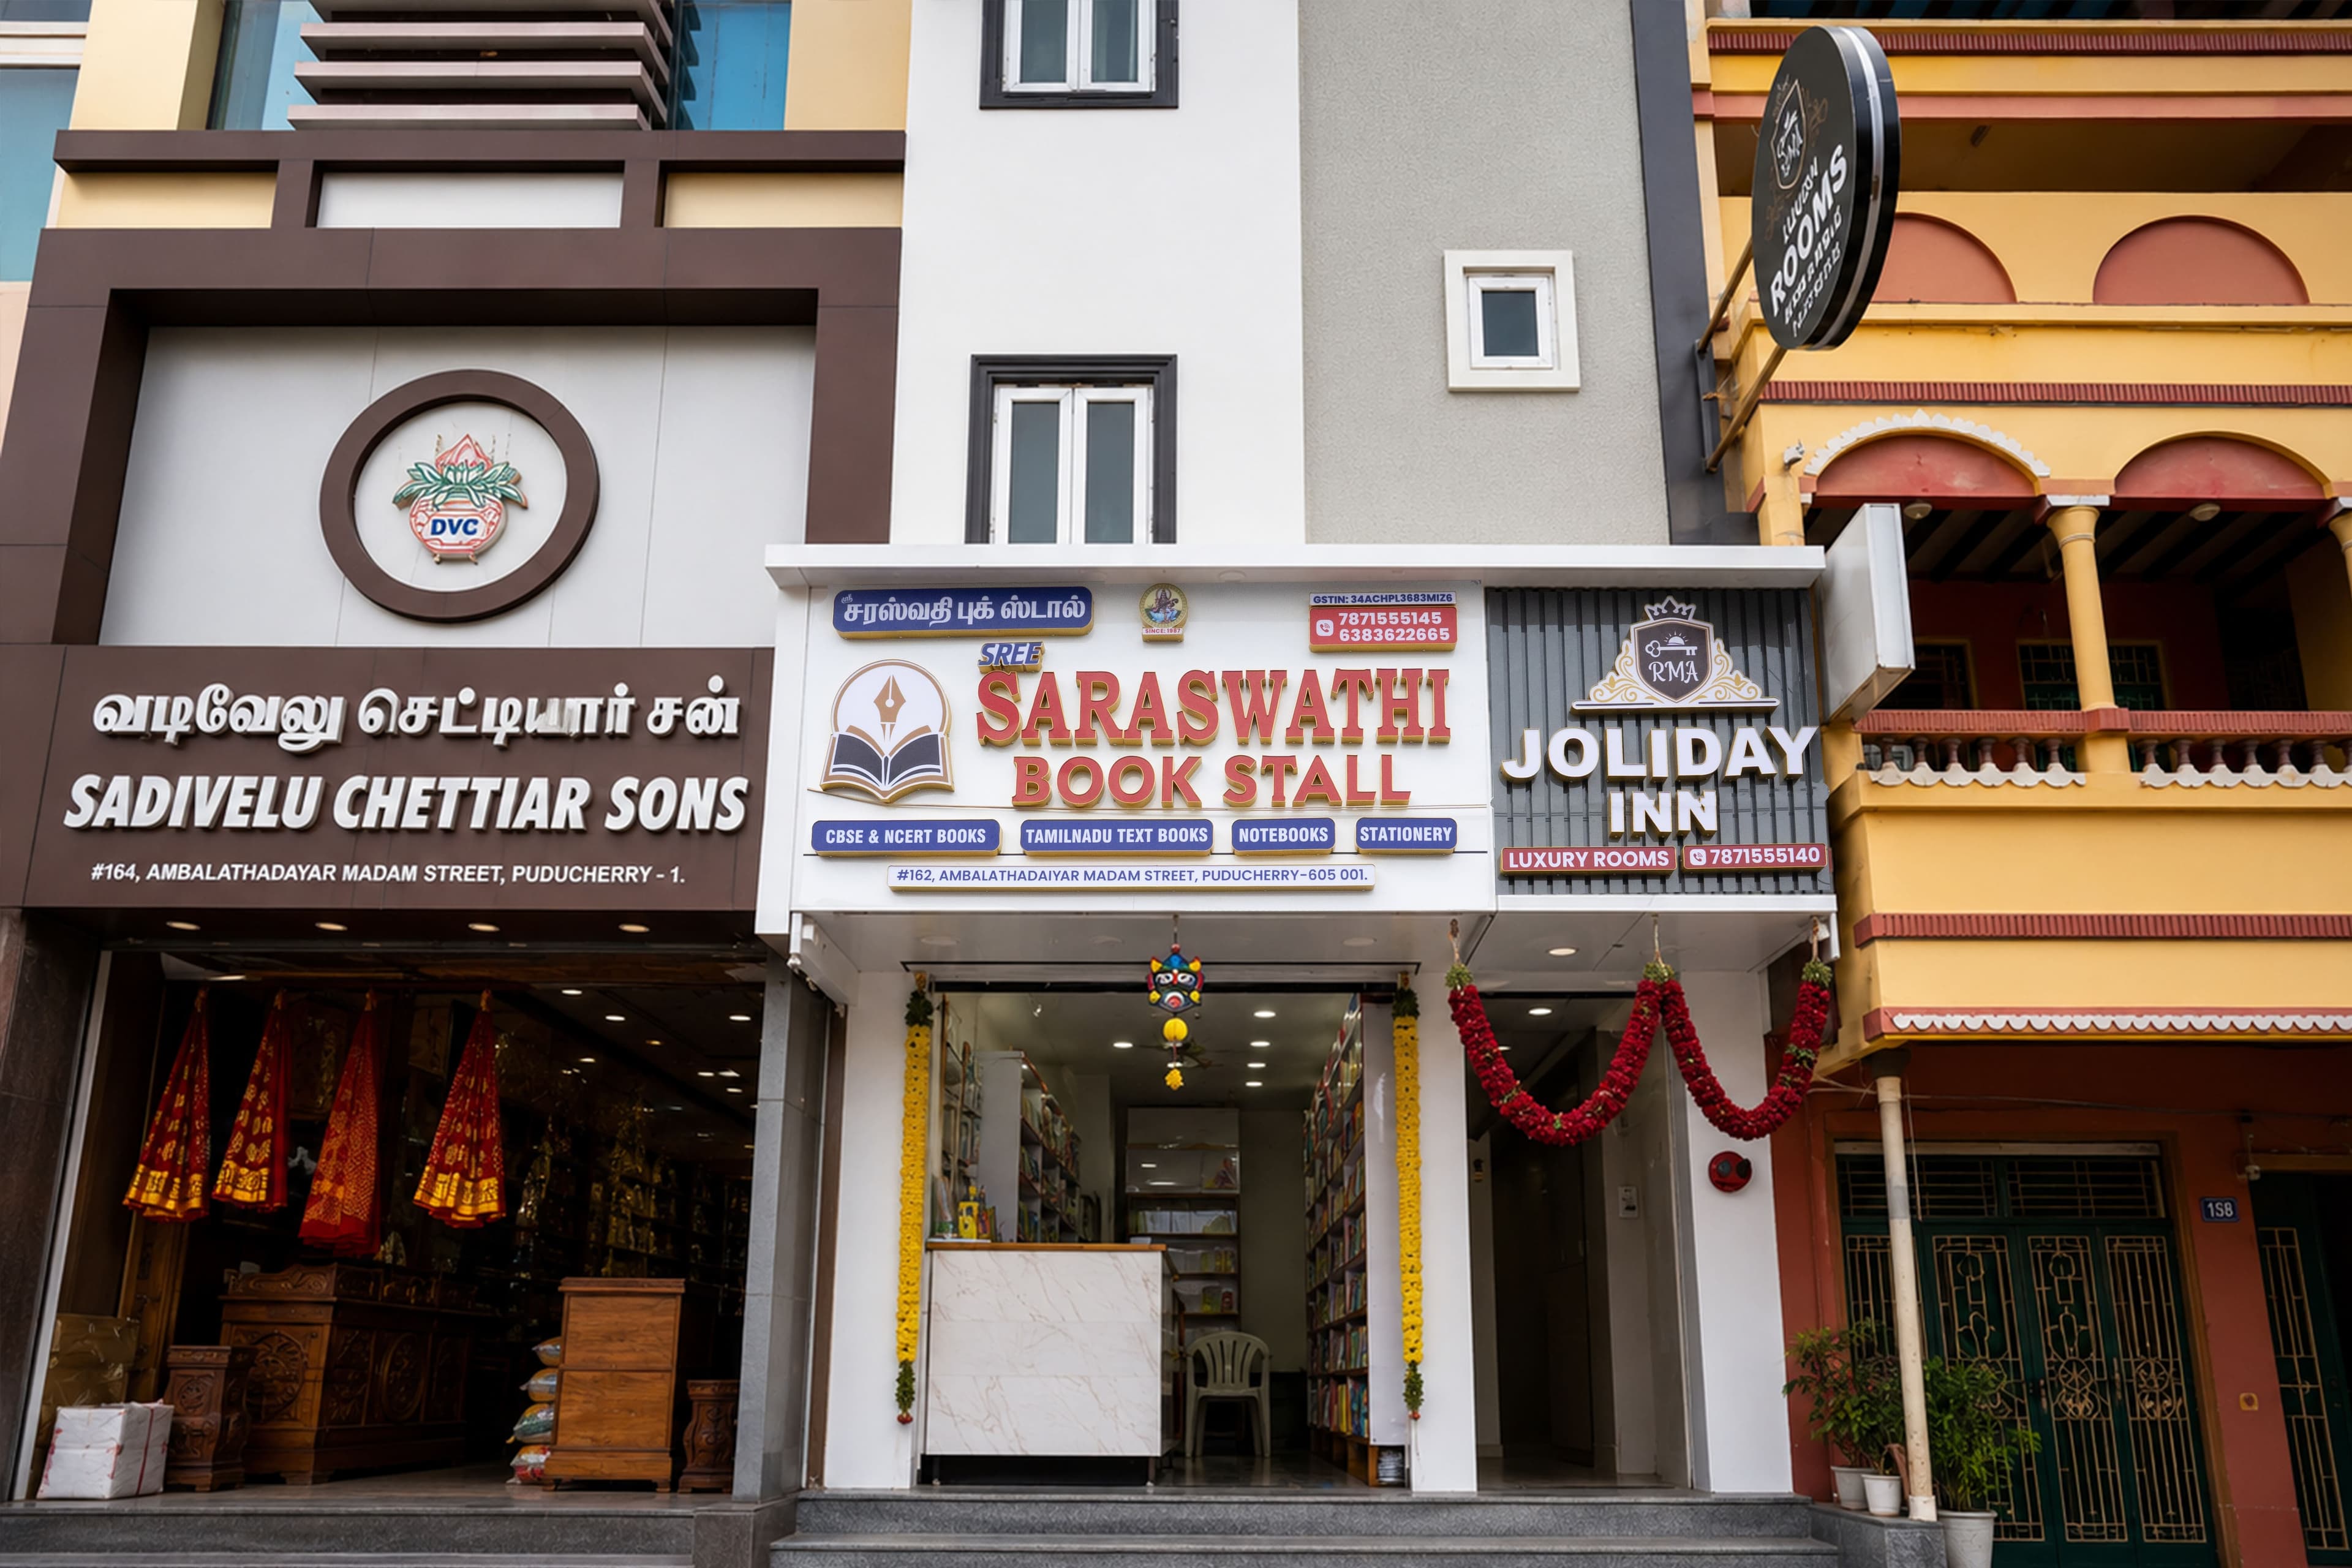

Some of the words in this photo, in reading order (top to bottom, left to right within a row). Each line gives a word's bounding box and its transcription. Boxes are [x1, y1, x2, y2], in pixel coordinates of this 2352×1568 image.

[1770, 144, 1847, 317] ROOMS
[431, 519, 479, 535] DVC
[844, 596, 952, 627] சரஸ்வதி
[957, 595, 995, 625] புக்
[1000, 594, 1086, 619] ஸ்டால்
[1338, 612, 1442, 625] 7871555145
[1339, 628, 1450, 641] 6383622665
[978, 642, 1044, 666] SREE
[1648, 661, 1700, 684] RMA
[646, 674, 741, 736] சன்
[976, 668, 1452, 746] SARASWATHI
[1501, 726, 1819, 783] JOLIDAY
[1012, 755, 1203, 807] BOOK
[1223, 754, 1411, 807] STALL
[63, 774, 325, 829] SADIVELU
[333, 774, 592, 831] CHETTIAR
[604, 775, 750, 832] SONS
[1608, 790, 1718, 839] INN
[826, 829, 864, 843] CBSE
[869, 829, 880, 843] &
[884, 829, 930, 843] NCERT
[937, 828, 986, 843] BOOKS
[1025, 828, 1112, 843] TAMILNADU
[1117, 828, 1153, 843] TEXT
[1158, 827, 1208, 843] BOOKS
[1239, 827, 1328, 843] NOTEBOOKS
[1360, 826, 1452, 842] STATIONERY
[1509, 851, 1589, 869] LUXURY
[1593, 850, 1670, 868] ROOMS
[1709, 848, 1821, 864] 7871555140
[91, 863, 141, 882] #164,
[145, 864, 336, 882] AMBALATHADAYAR
[341, 864, 418, 883] MADAM
[423, 865, 506, 885] STREET,
[511, 865, 653, 883] PUDUCHERRY
[669, 866, 685, 883] 1.
[897, 869, 935, 883] #162,
[939, 870, 1079, 882] AMBALATHADAIYAR
[1084, 869, 1140, 881] MADAM
[1144, 869, 1199, 884] STREET,
[1340, 869, 1368, 881] 001.
